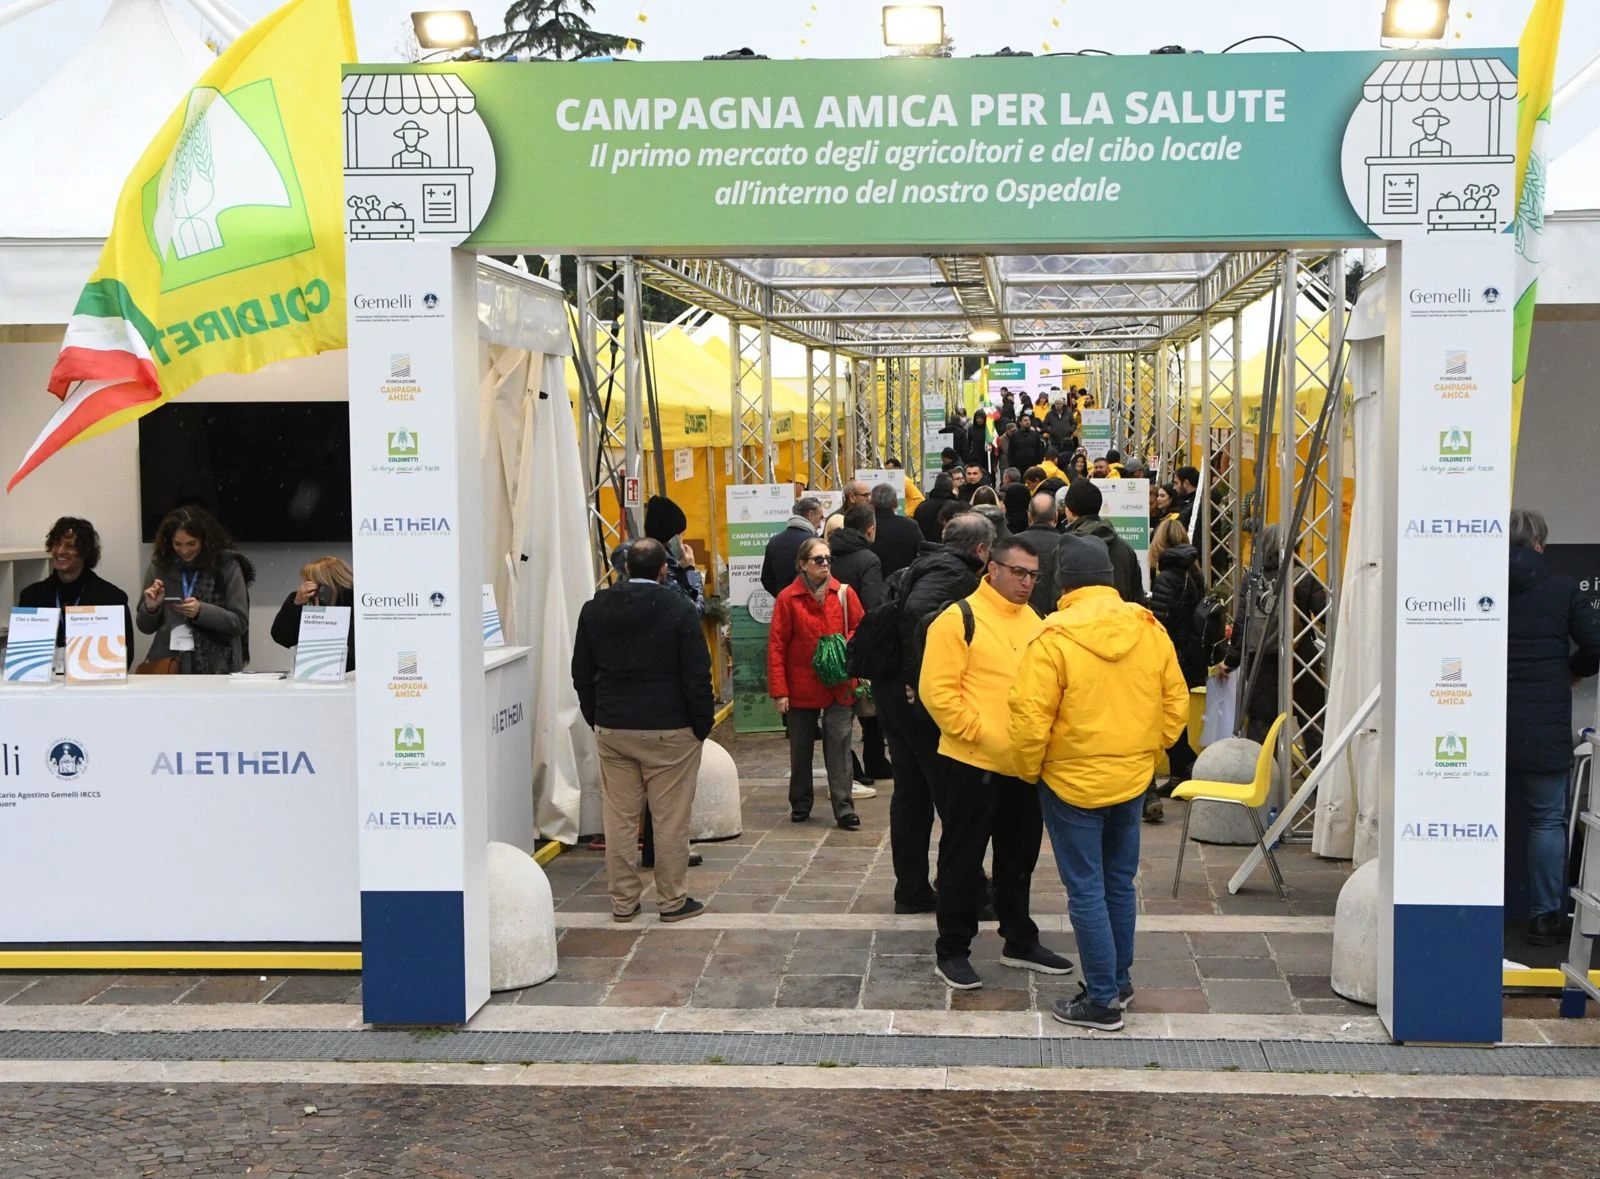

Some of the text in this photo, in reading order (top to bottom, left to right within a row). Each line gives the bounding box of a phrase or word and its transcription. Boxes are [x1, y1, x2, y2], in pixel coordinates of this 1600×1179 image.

[556, 89, 1286, 132] CAMPAGNA AMICA PER LA SALUTE
[590, 135, 1242, 175] Il primo mercato degli agricoltori e del cibo locale
[715, 176, 1121, 210] all’interno del nostro Ospedale
[354, 294, 412, 309] Gemelli
[1410, 288, 1471, 304] Gemelli
[359, 518, 450, 532] ALETHEIA
[1405, 520, 1503, 533] ALETHEIA
[1580, 580, 1590, 592] e
[362, 592, 418, 607] Gemelli
[1405, 597, 1466, 612] Gemelli
[150, 750, 316, 776] ALETHEIA
[18, 792, 49, 800] Agostino
[366, 812, 456, 825] ALETHEIA
[1402, 823, 1498, 837] ALETHEIA
